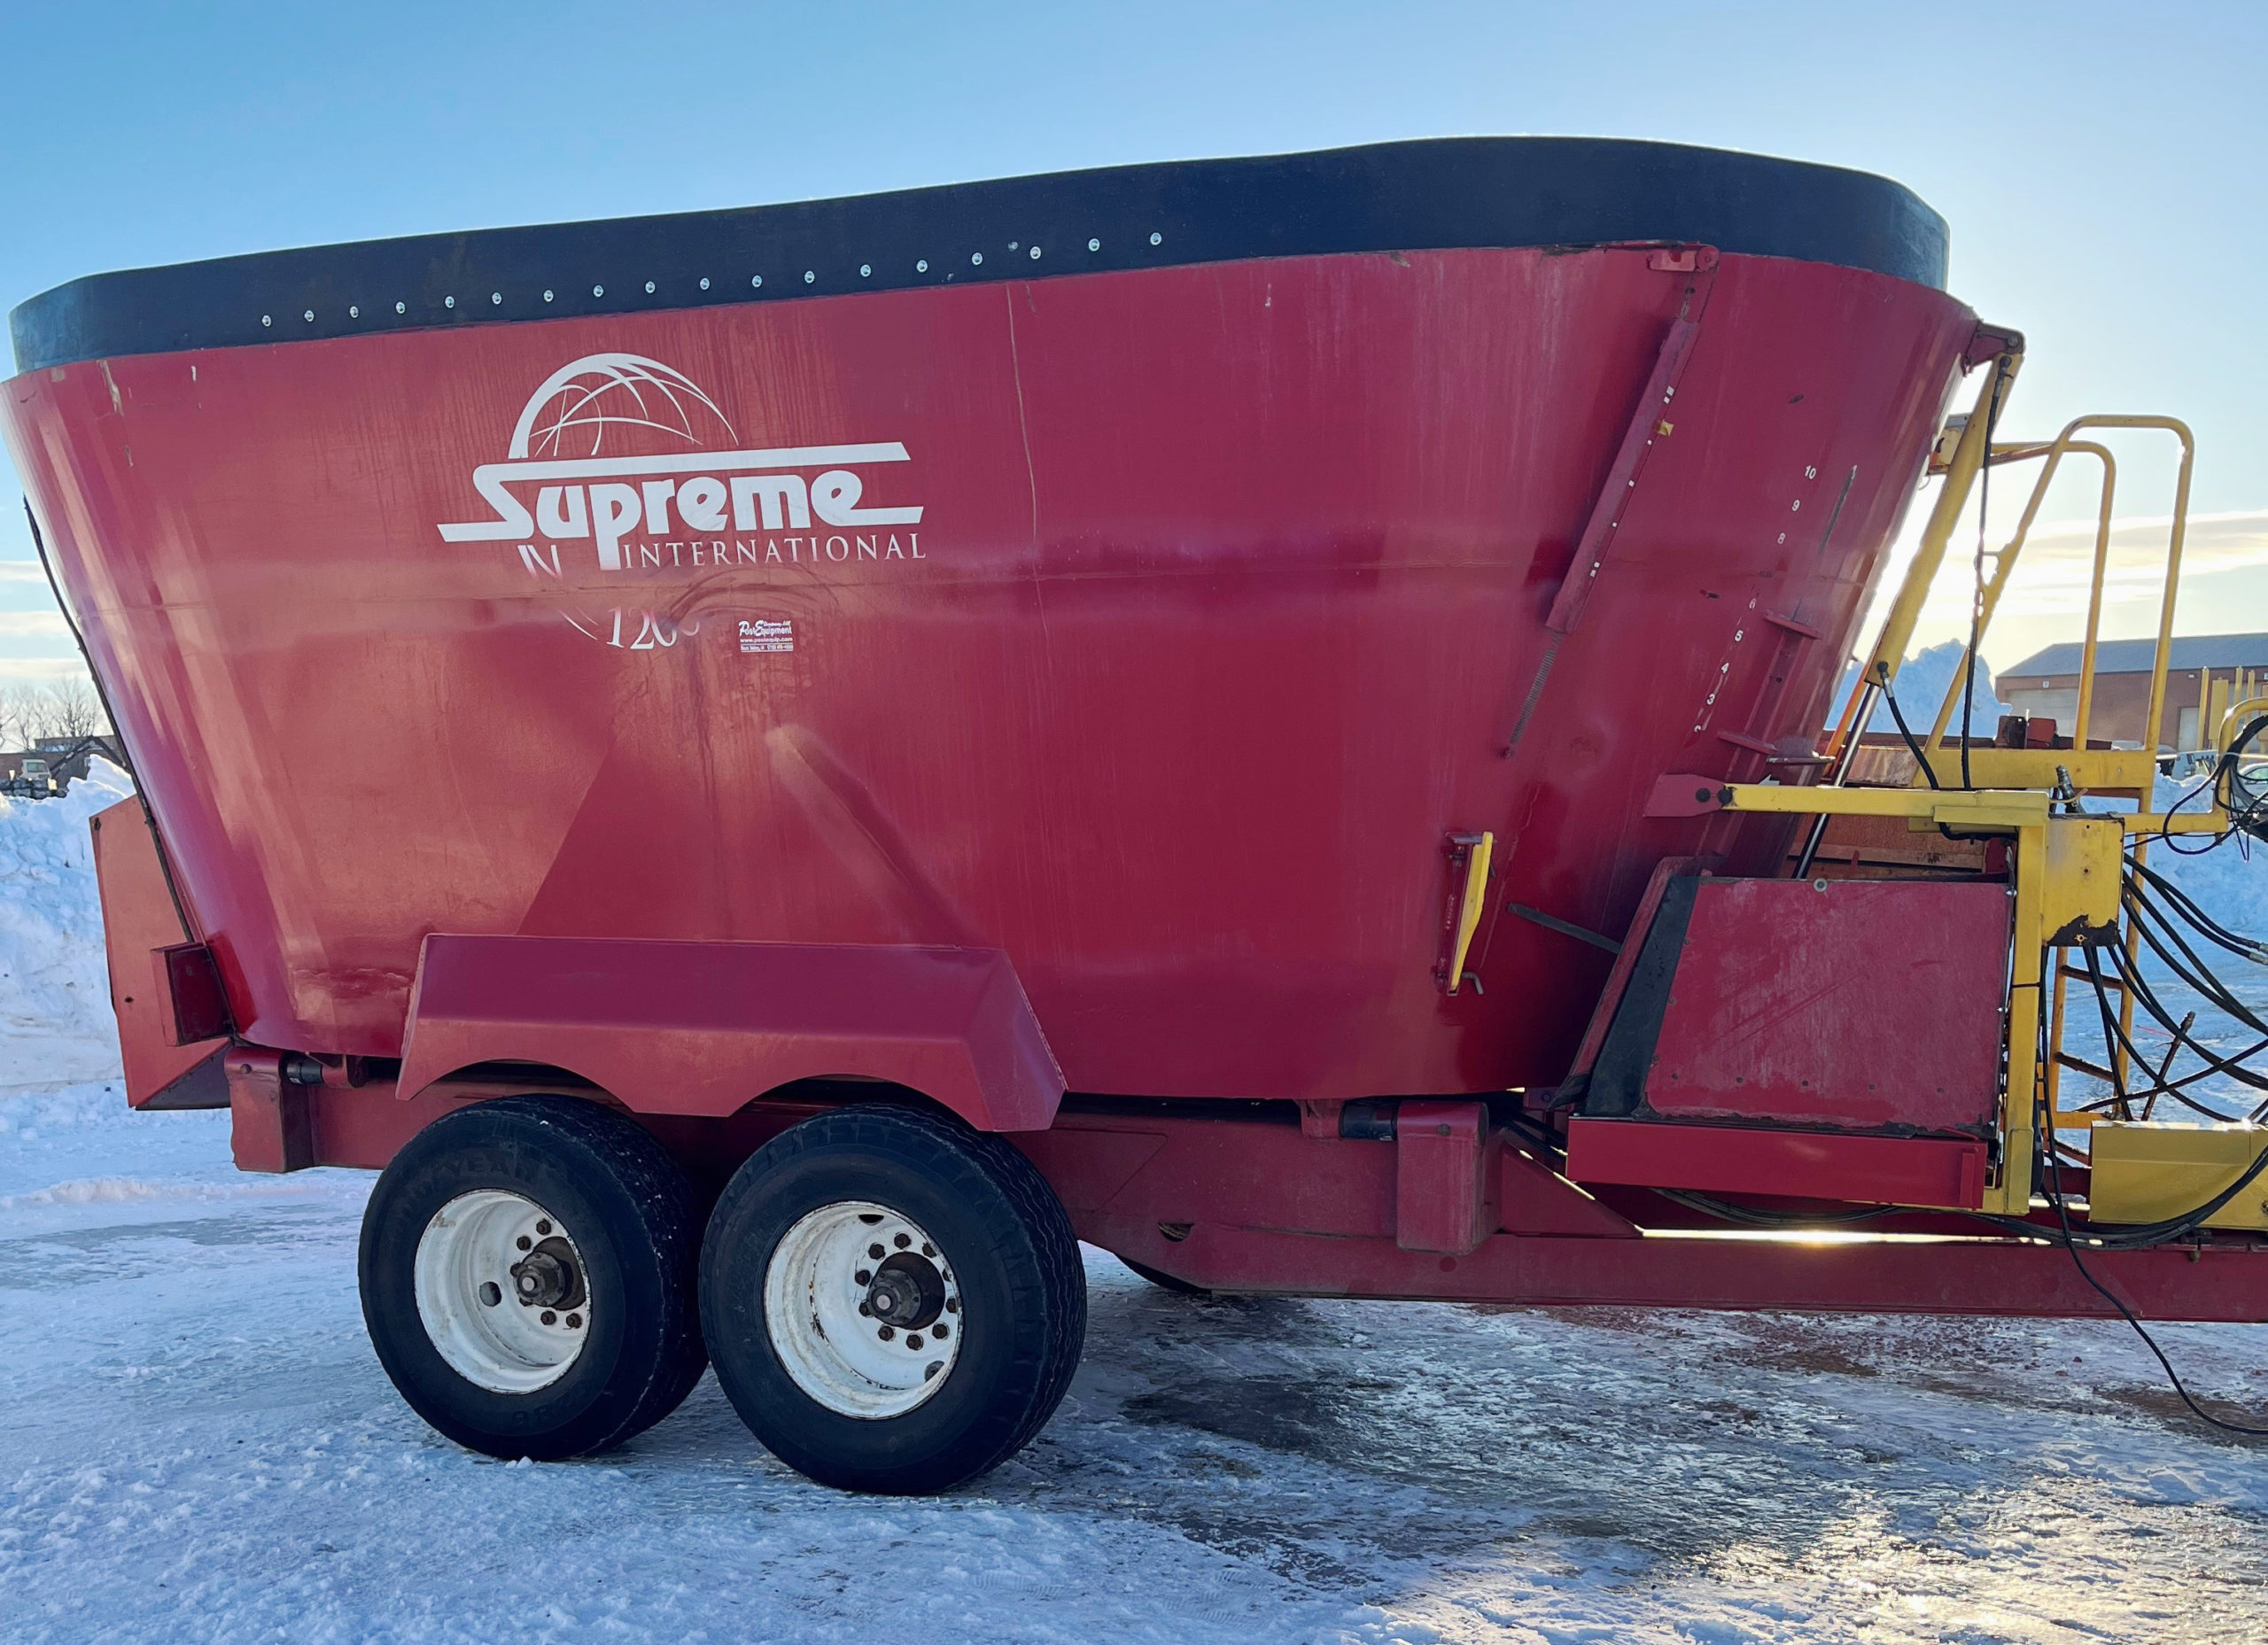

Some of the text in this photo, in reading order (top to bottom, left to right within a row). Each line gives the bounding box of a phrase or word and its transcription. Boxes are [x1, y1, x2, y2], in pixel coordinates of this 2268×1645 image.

[1804, 465, 1817, 479] 10
[437, 441, 924, 570] Supreme
[1791, 499, 1800, 512] 9
[1776, 532, 1786, 545] 8
[622, 532, 926, 570] INTERNATIONAL
[1734, 630, 1744, 642] 5
[1720, 663, 1729, 674] 4
[1706, 693, 1716, 705] 3
